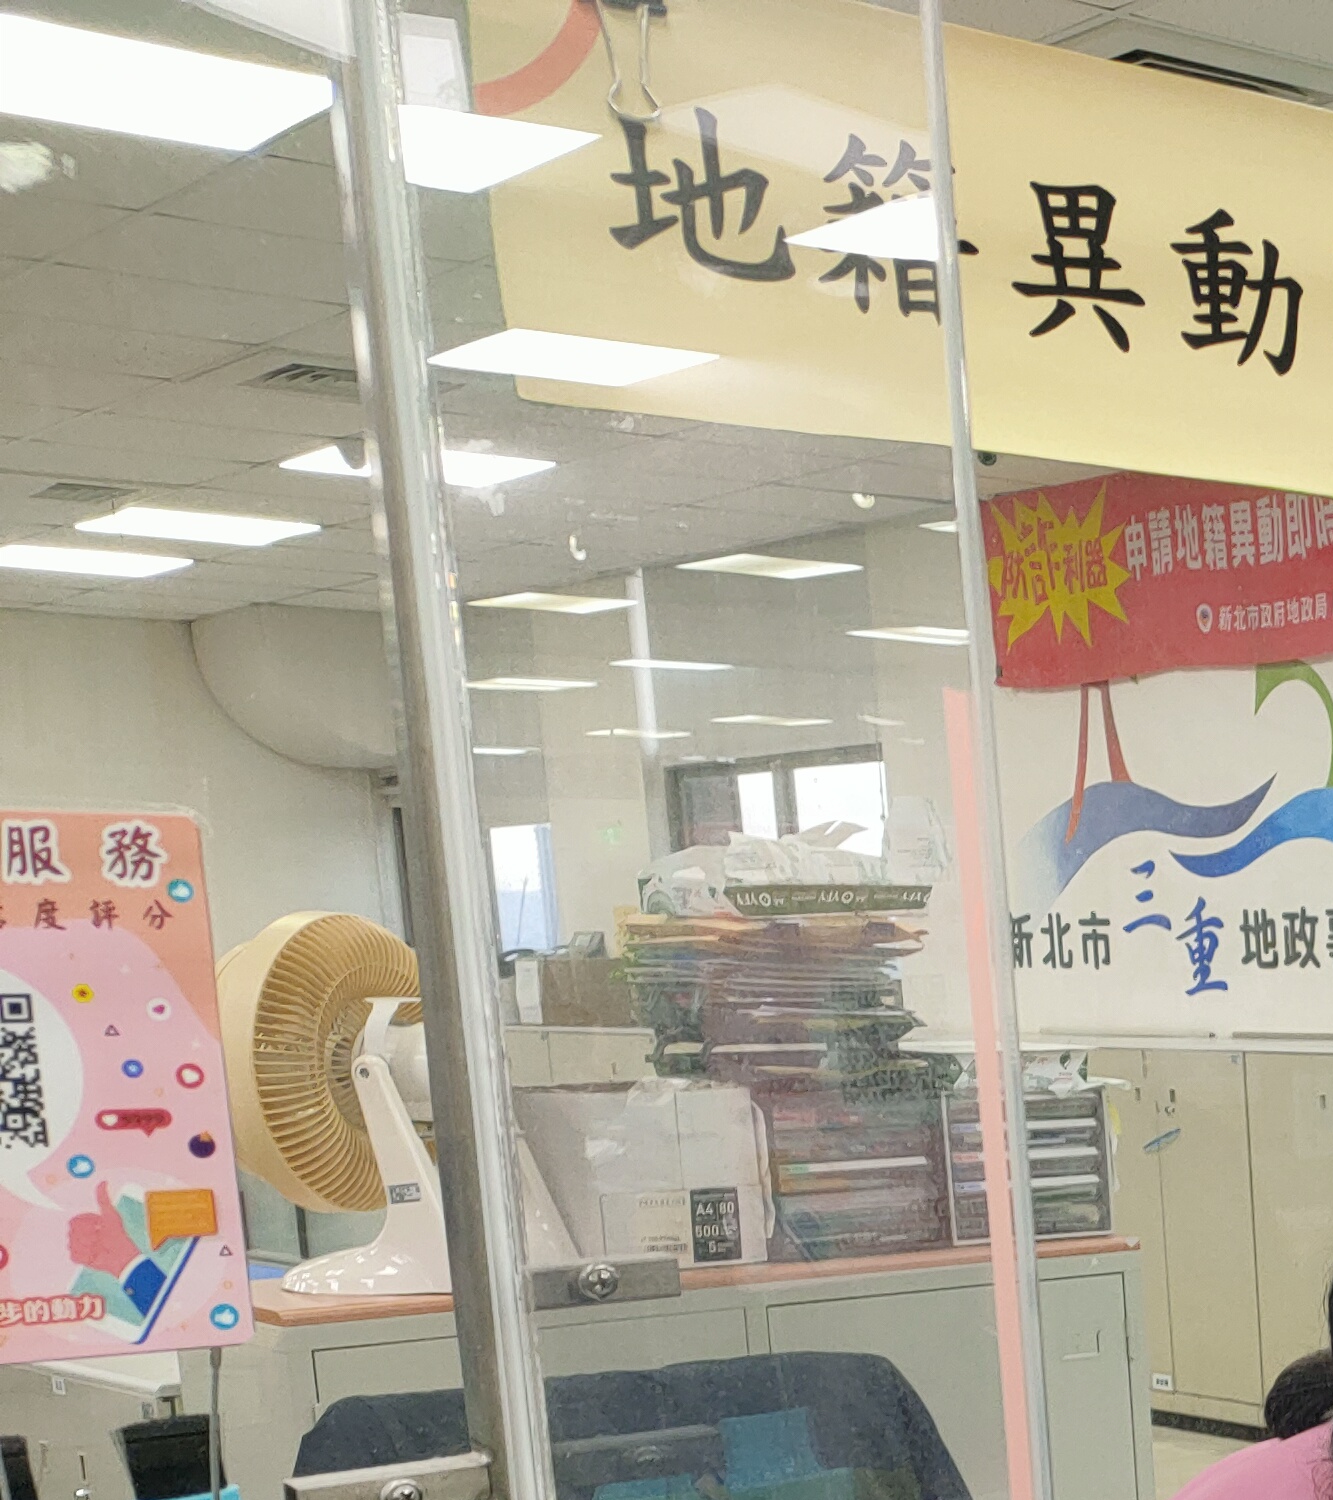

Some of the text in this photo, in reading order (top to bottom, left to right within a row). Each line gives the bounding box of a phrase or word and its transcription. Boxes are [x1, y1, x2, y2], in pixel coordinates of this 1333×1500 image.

[1001, 517, 1108, 605] 防詐利器
[6, 824, 166, 882] 服務
[0, 898, 174, 931] 度評分
